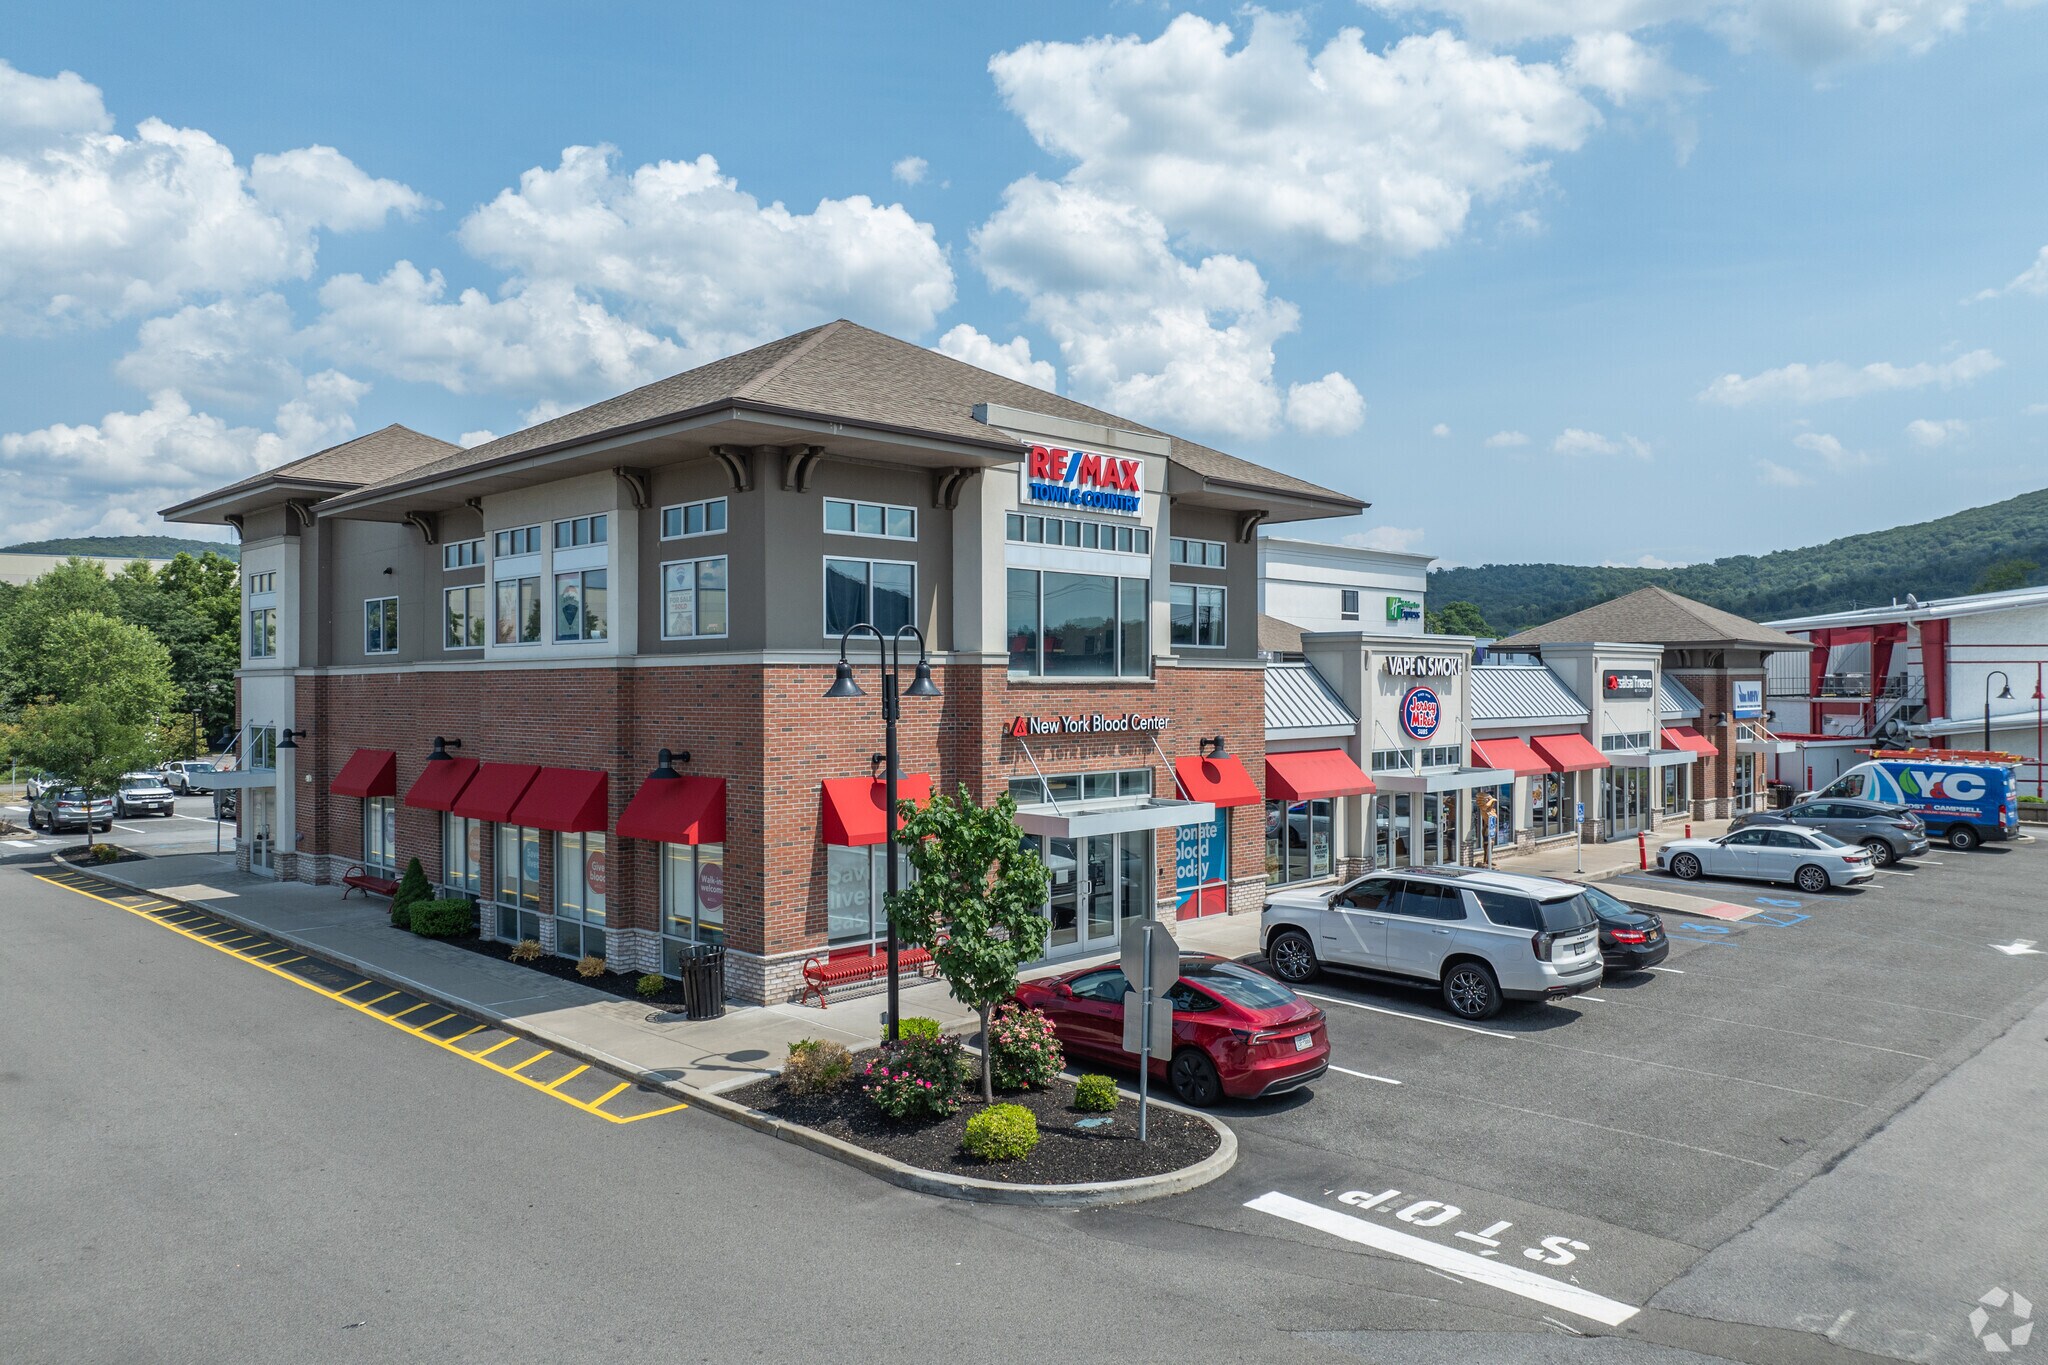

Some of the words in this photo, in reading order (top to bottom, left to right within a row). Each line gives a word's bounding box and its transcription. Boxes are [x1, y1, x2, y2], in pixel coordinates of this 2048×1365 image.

[1029, 445, 1140, 491] RE/MAX
[1029, 483, 1069, 503] TOWN
[1070, 488, 1082, 505] &
[1081, 491, 1140, 511] COUNTRY
[1401, 608, 1421, 620] Express
[1388, 656, 1415, 675] VAPE
[1417, 658, 1426, 676] N
[1428, 657, 1462, 676] SMOKE
[1410, 696, 1437, 717] Jersey
[1030, 717, 1059, 734] New
[1063, 715, 1090, 733] York
[1092, 713, 1128, 732] Blood
[1131, 713, 1170, 731] Center
[1934, 804, 1983, 813] CAMPBELL
[1176, 823, 1217, 841] Donate
[592, 861, 605, 872] Give
[1176, 859, 1209, 880] ody
[831, 888, 868, 909] live
[830, 912, 867, 931] eas
[1338, 1188, 1591, 1267] STOP
